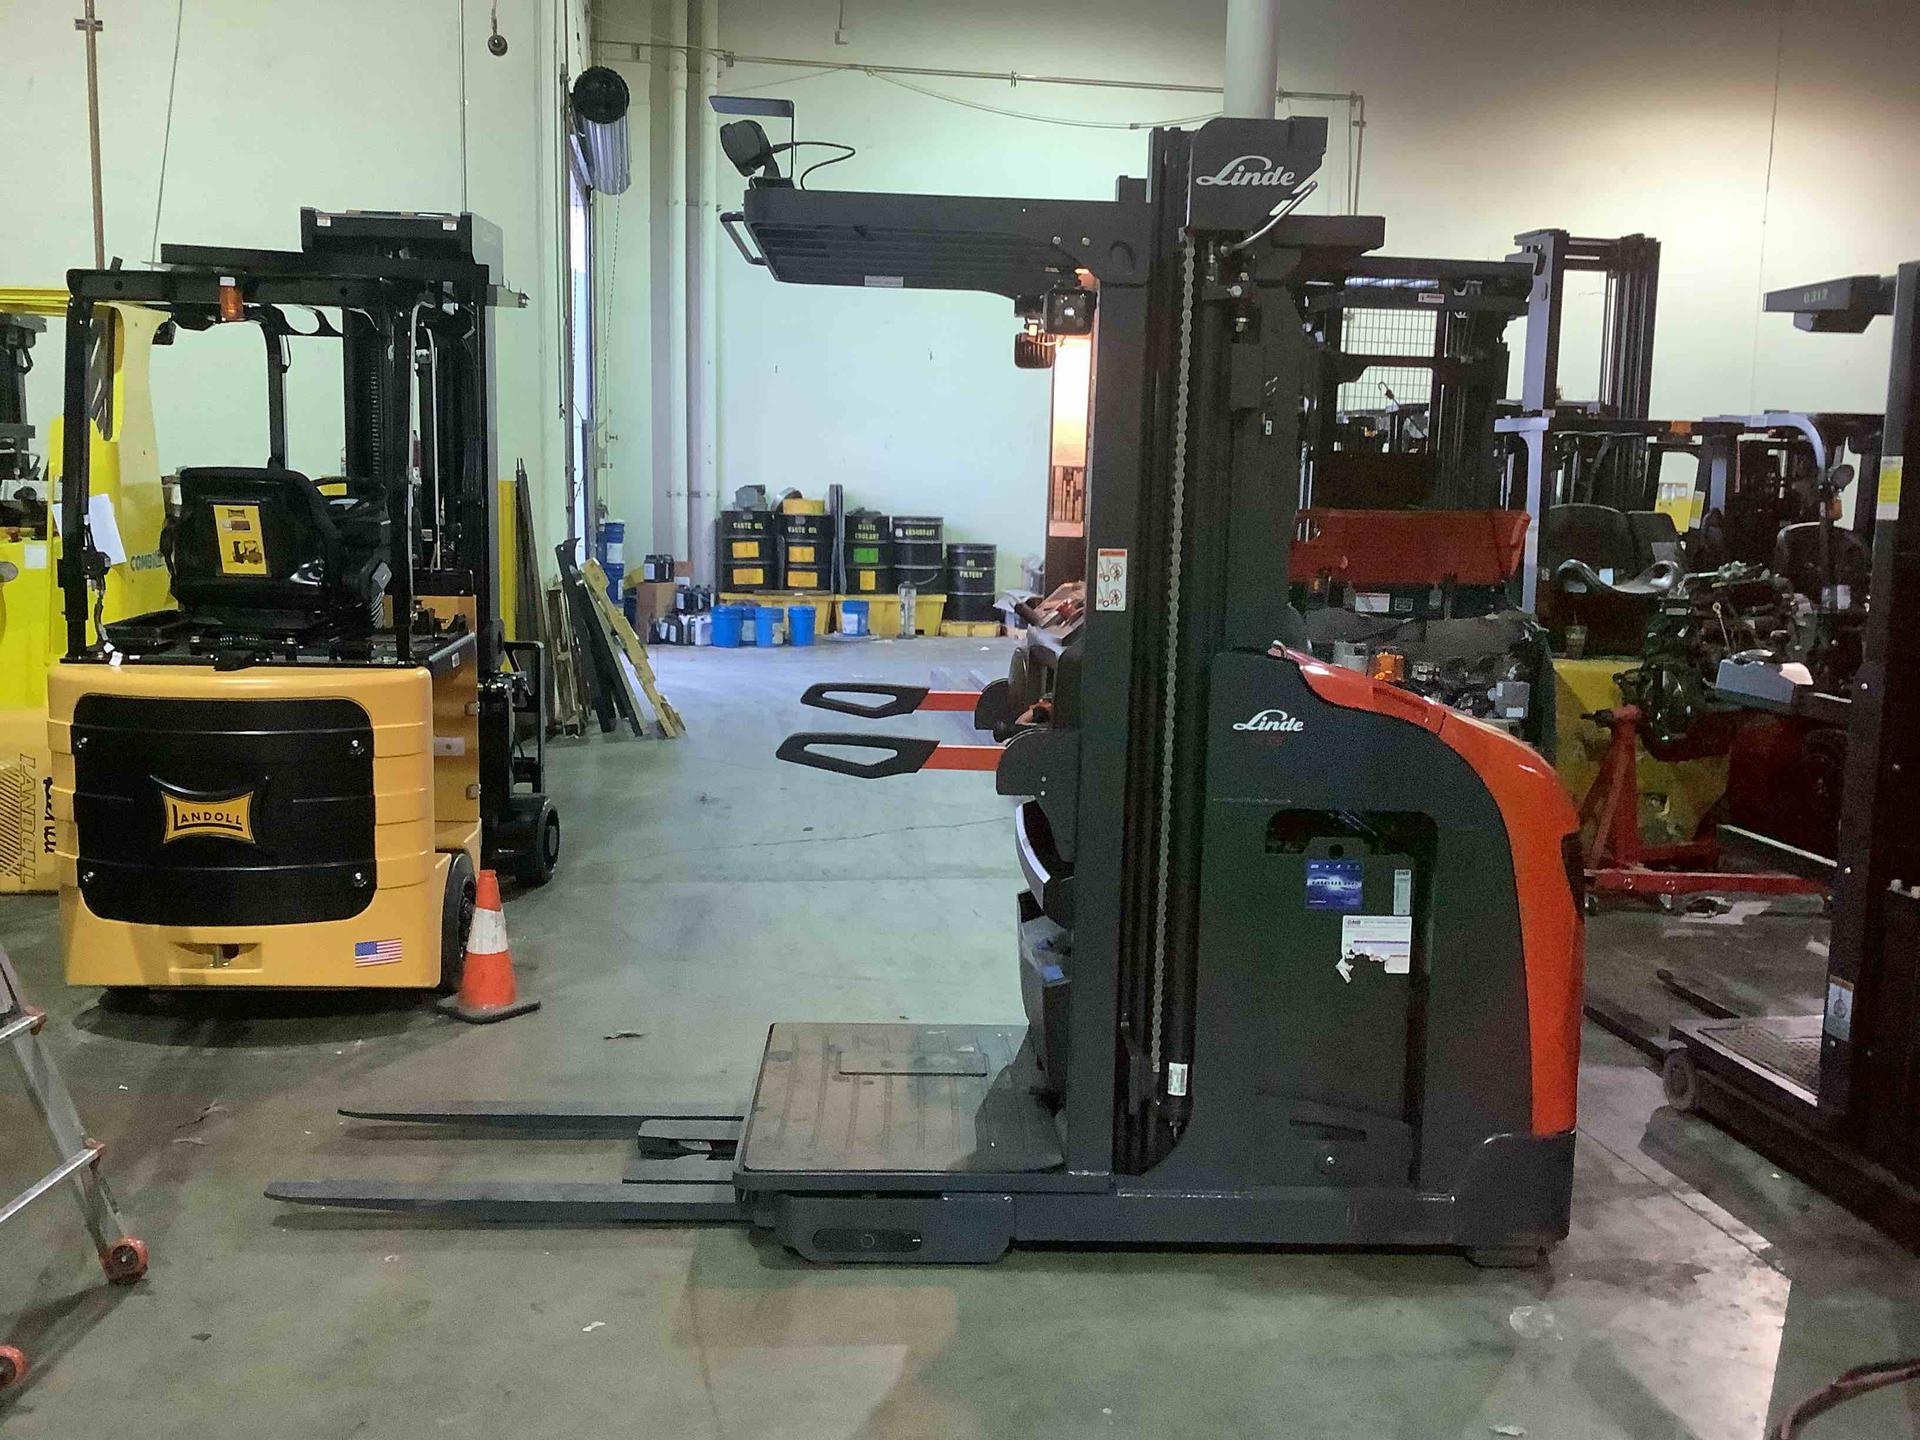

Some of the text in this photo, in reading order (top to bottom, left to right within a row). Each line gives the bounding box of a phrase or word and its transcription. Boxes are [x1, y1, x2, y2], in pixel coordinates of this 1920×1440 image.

[1195, 155, 1296, 186] Linde
[733, 522, 764, 530] WASTE OIL
[787, 526, 817, 534] WASTE OIL
[966, 559, 976, 567] OIL
[1232, 708, 1304, 732] Linde
[172, 803, 244, 832] LANDOLL
